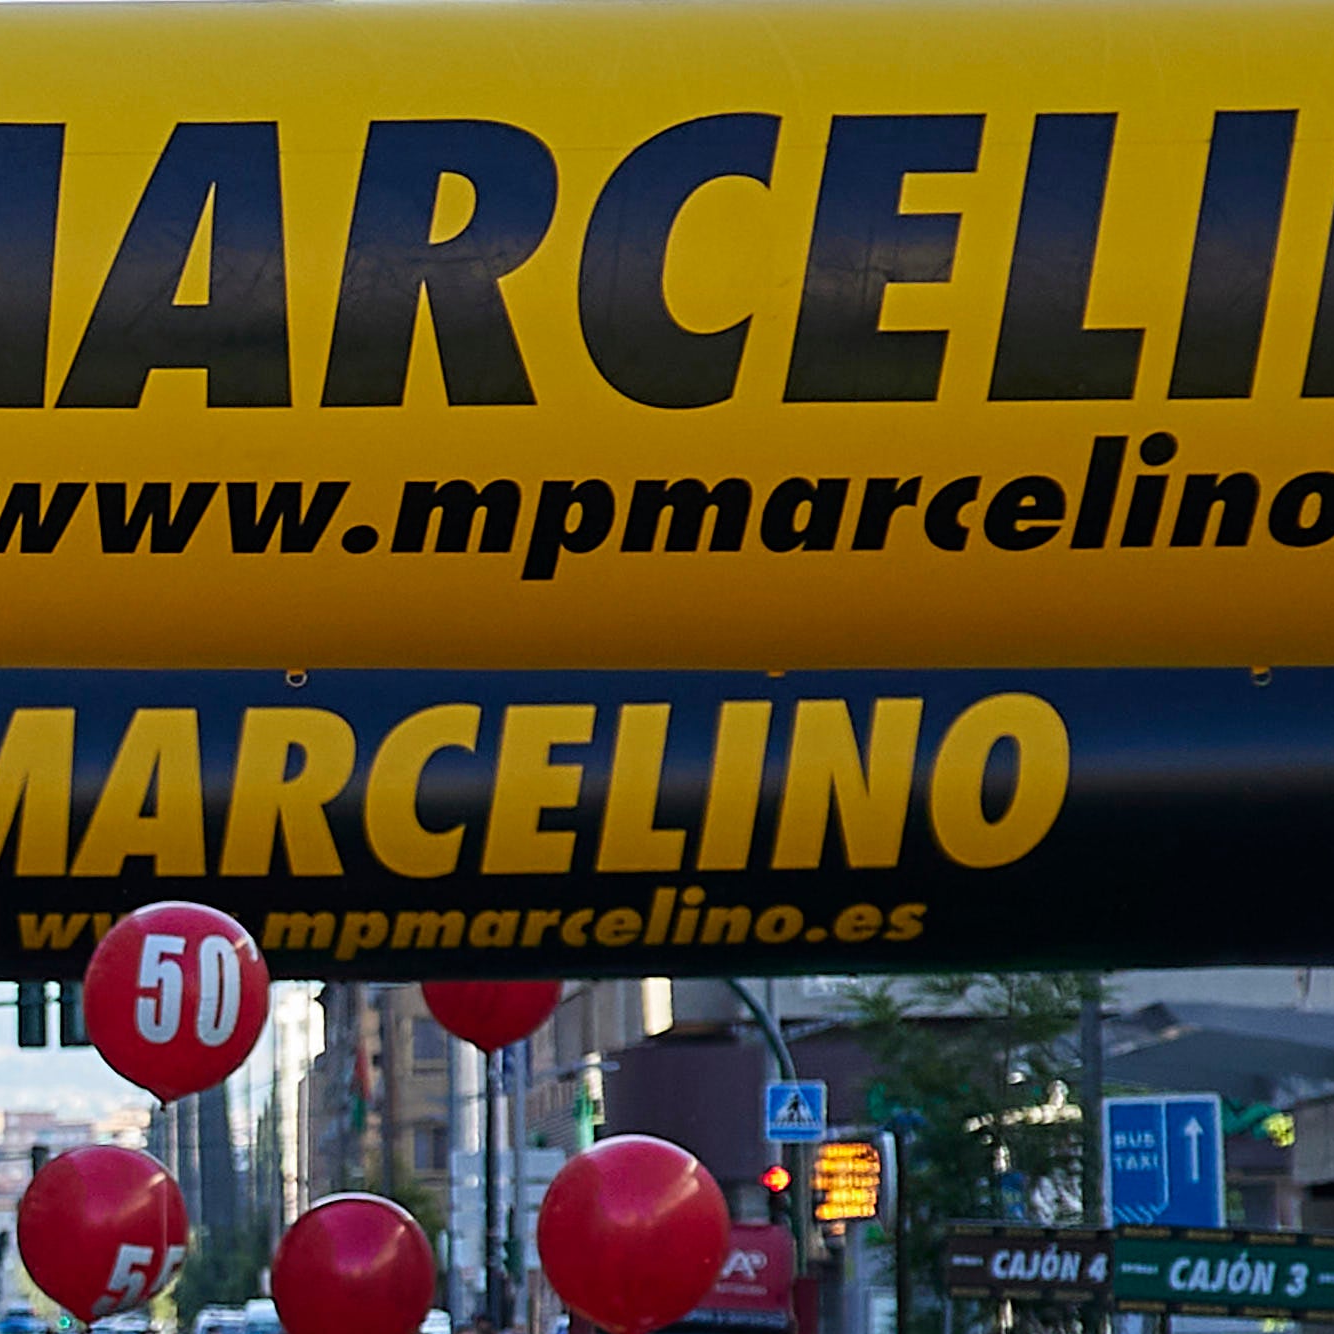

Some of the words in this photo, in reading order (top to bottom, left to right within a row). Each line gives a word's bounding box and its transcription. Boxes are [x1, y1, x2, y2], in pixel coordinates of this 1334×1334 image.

[1114, 1131, 1156, 1147] BUS
[1113, 1154, 1159, 1170] TAXI
[991, 1242, 1080, 1281] CAJÓN
[1088, 1253, 1108, 1282] 4
[1169, 1252, 1275, 1296] CAJÓN
[1285, 1263, 1309, 1297] 3
